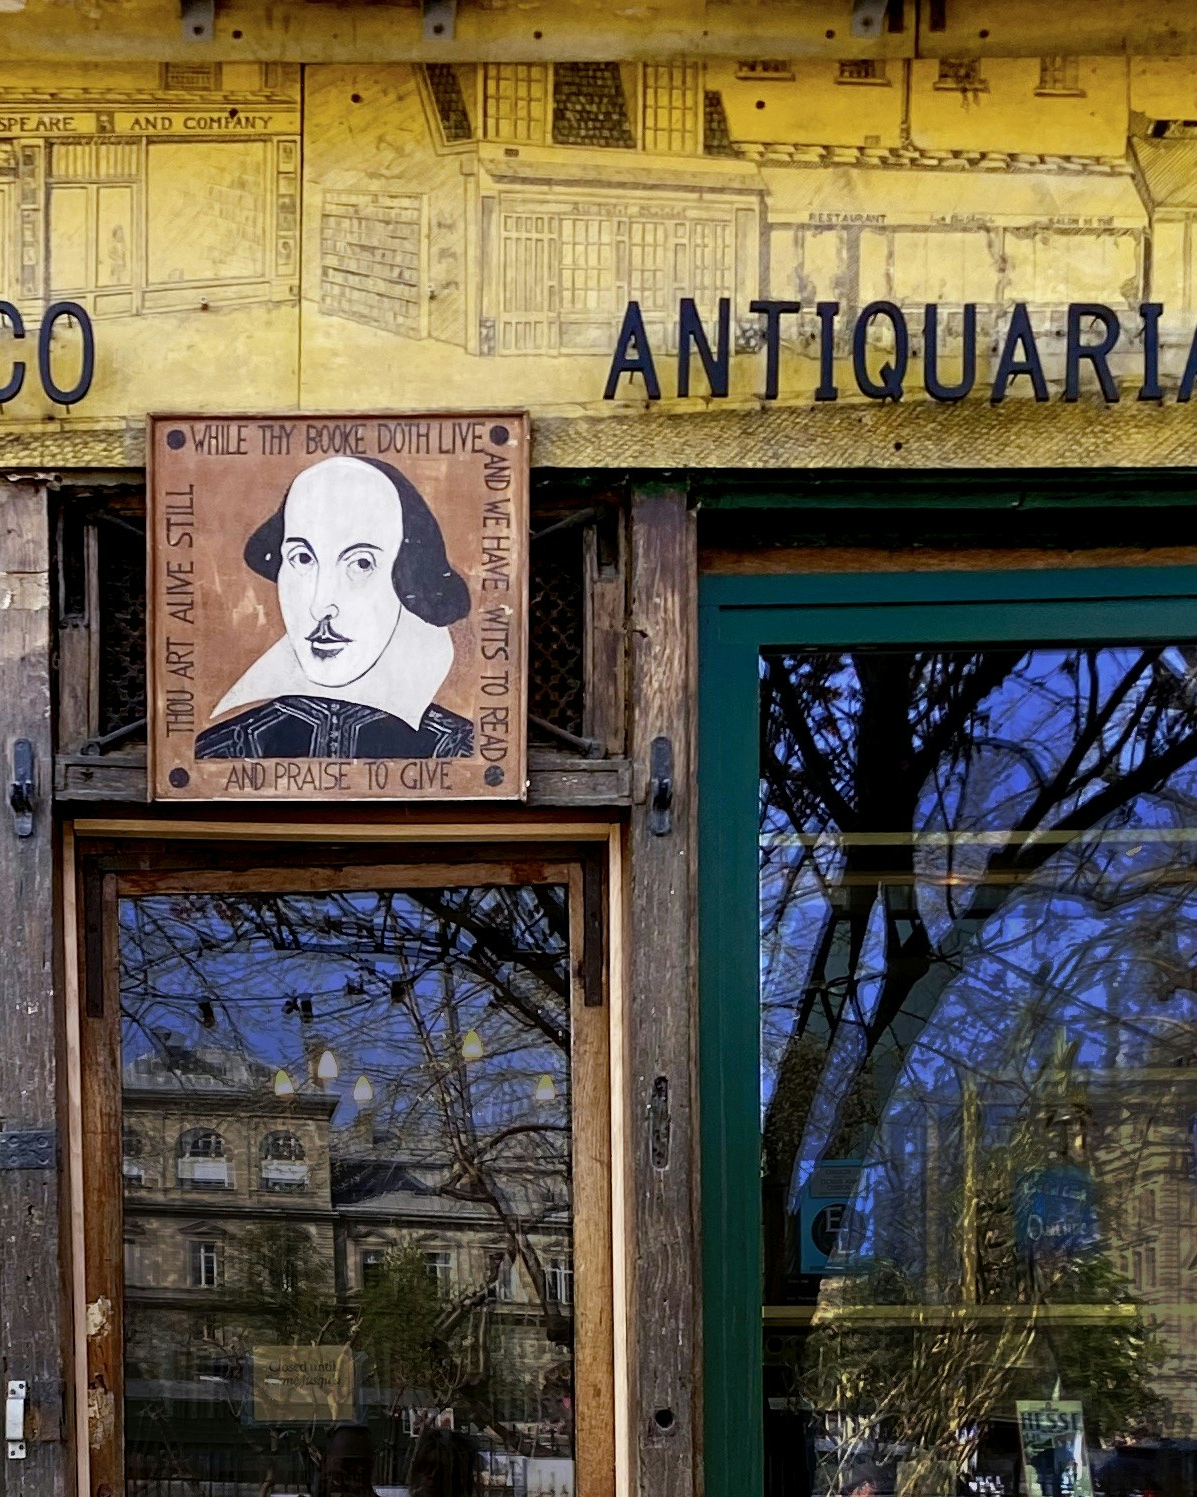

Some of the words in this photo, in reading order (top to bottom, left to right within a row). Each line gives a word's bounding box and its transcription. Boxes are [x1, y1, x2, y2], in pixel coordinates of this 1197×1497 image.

[130, 115, 174, 132] AND
[183, 115, 273, 131] COMPANY
[603, 297, 1197, 403] ANTIQUARI
[190, 424, 249, 455] WHILE
[258, 424, 299, 454] THY
[305, 424, 368, 455] BOOKE
[377, 423, 431, 453] DOTH
[438, 421, 486, 453] LIVE
[483, 453, 511, 491] AND
[164, 484, 195, 548] STILL
[482, 499, 511, 529] WE
[481, 536, 511, 592] HAVE
[165, 561, 195, 625] ALIVE
[480, 608, 510, 661] WITS
[165, 636, 195, 681] ART
[480, 673, 510, 697] TO
[166, 689, 195, 738] THOU
[479, 706, 509, 763] READ
[225, 762, 267, 791] AND
[274, 762, 352, 792] PRAISE
[367, 762, 389, 790] TO
[399, 761, 453, 791] GIVE
[1021, 1410, 1081, 1432] HESSE
